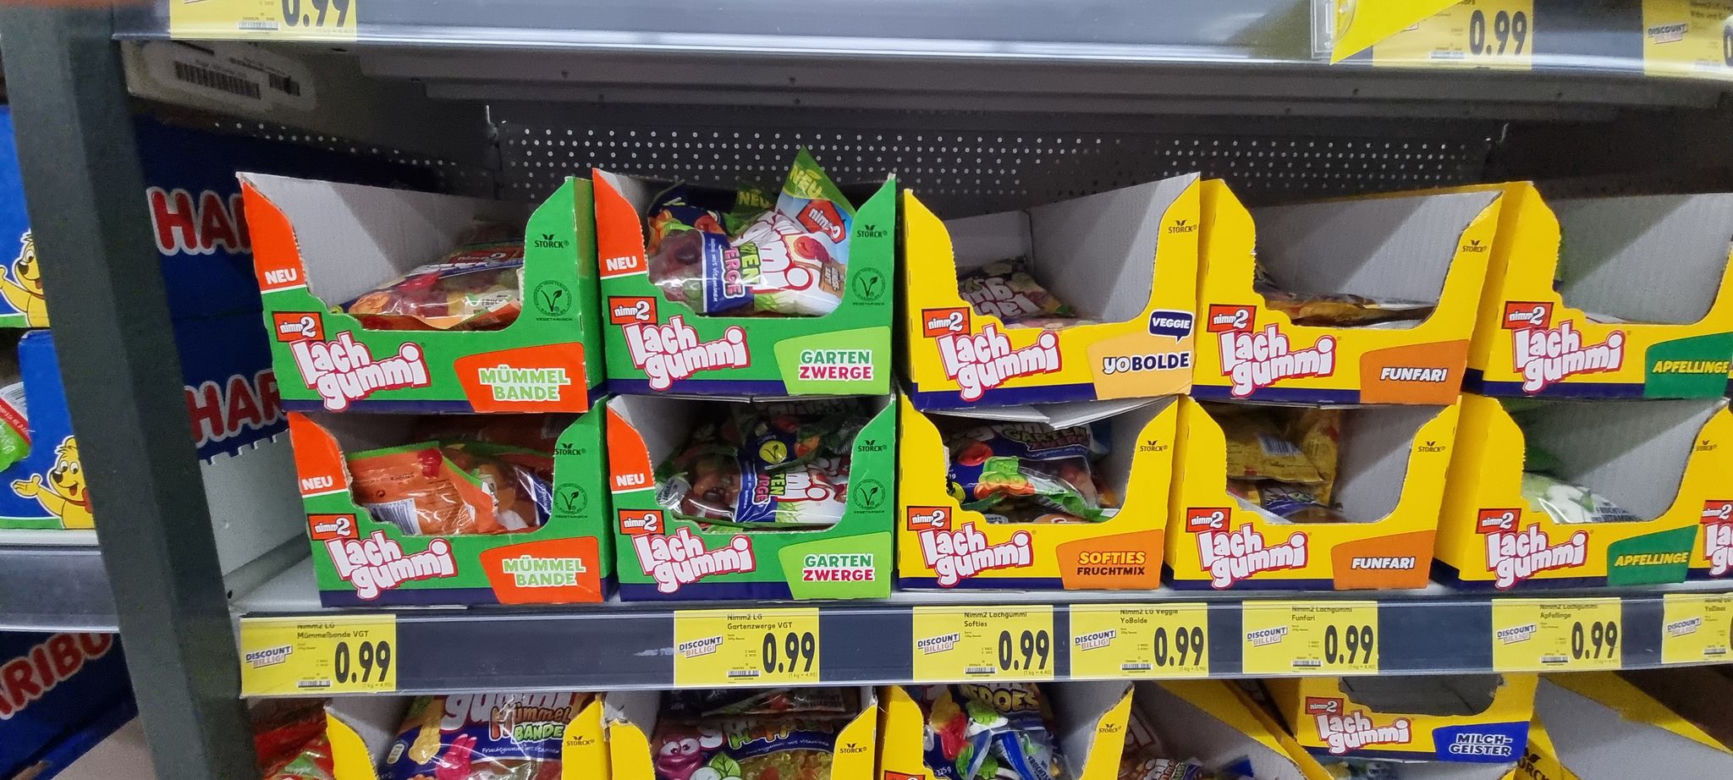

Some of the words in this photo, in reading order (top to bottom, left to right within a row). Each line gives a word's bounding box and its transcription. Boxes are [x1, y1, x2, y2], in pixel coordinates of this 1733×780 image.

[1470, 10, 1528, 55] 0.99
[534, 240, 564, 248] STORCK
[606, 256, 637, 271] NEU
[265, 268, 297, 284] NEU
[1152, 317, 1190, 330] VEGGIE
[646, 327, 748, 389] gummi
[800, 350, 870, 365] GARTEN
[1524, 333, 1624, 392] gummi
[799, 366, 872, 379] ZWERGE
[958, 333, 1060, 399] gummi
[1232, 338, 1334, 396] gummi
[1653, 360, 1729, 374] APFELLINGE
[317, 343, 428, 411] gummi
[480, 366, 568, 384] MÜMMEL
[1380, 368, 1448, 383] FUNFARI
[493, 386, 559, 400] BANDE
[301, 477, 333, 490] NEU
[616, 474, 645, 487] NEU
[503, 556, 586, 573] MÜMMEL
[655, 535, 753, 593] gummi
[804, 554, 872, 568] GARTEN
[938, 531, 1032, 587] gummi
[1079, 552, 1146, 565] SOFTIES
[1212, 532, 1306, 588] gummi
[1352, 557, 1415, 570] FUNFARI
[1497, 532, 1586, 587] gummi
[1614, 552, 1688, 567] APFELLINGE
[351, 540, 454, 599] gummi
[803, 569, 874, 582] ZWERGE
[1077, 567, 1145, 576] FRUCHTMIX
[515, 574, 576, 587] BANDE
[727, 622, 776, 630] Gartenzwerge
[1497, 625, 1534, 638] DISCOUNT
[1667, 618, 1700, 631] DISCOUNT
[918, 634, 958, 647] DISCOUNT
[1075, 630, 1114, 644] DISCOUNT
[1247, 627, 1286, 640] DISCOUNT
[1572, 621, 1617, 660] 0.99
[679, 637, 721, 651] DISCOUNT
[999, 630, 1049, 671] 0.99
[1154, 627, 1204, 667] 0.99
[1325, 625, 1373, 664] 0.99
[246, 646, 291, 661] DISCOUNT
[762, 632, 815, 673] 0.99
[335, 641, 390, 683] 0.99
[514, 724, 565, 742] BANDE
[1329, 719, 1409, 754] gummi
[1457, 733, 1513, 745] MILCH-
[1449, 744, 1512, 756] GEISTER
